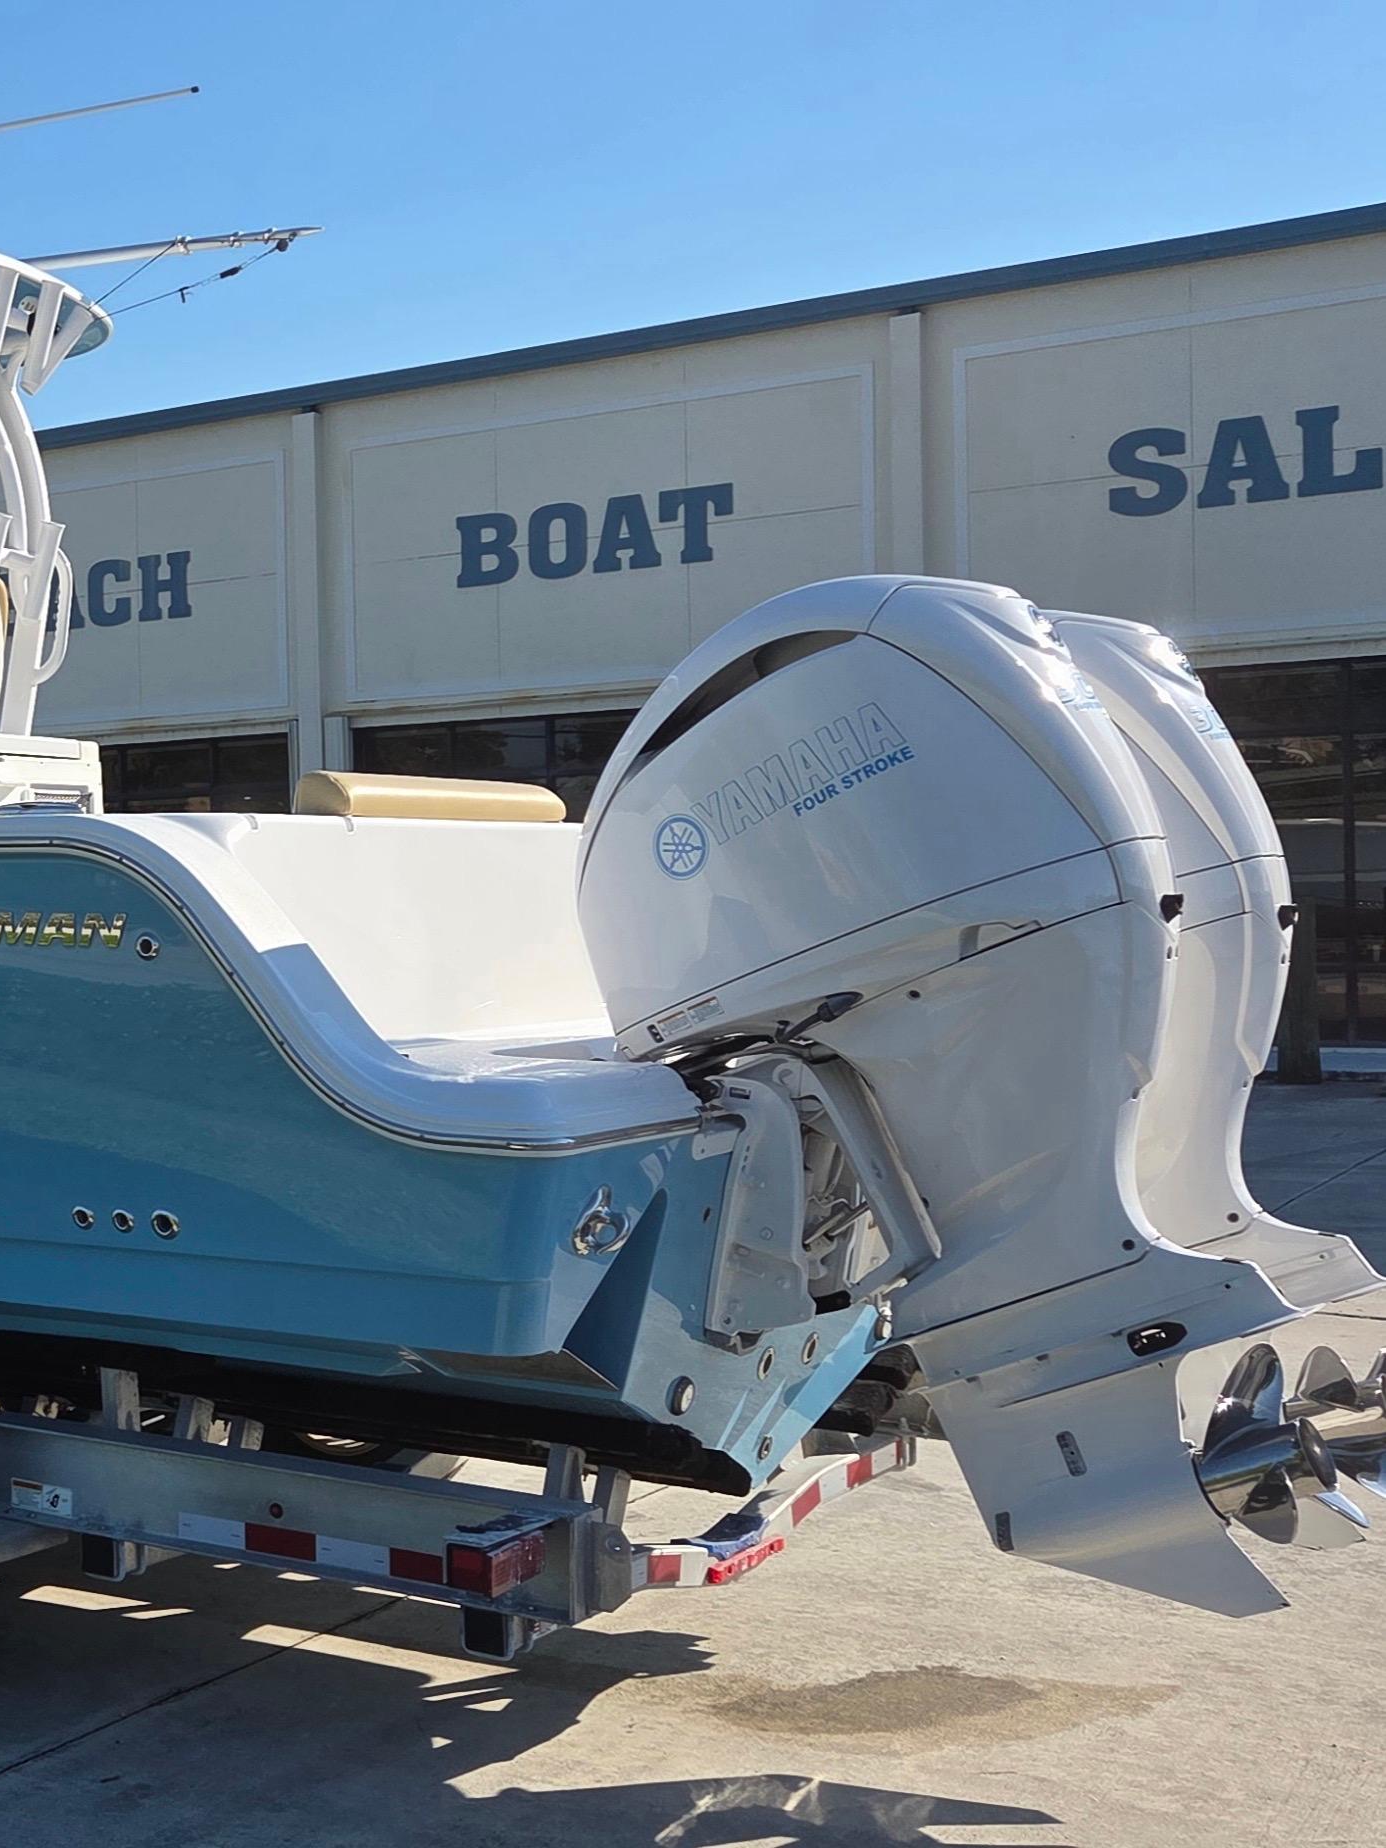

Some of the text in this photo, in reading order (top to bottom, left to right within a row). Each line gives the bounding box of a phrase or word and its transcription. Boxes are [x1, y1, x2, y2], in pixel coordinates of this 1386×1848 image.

[456, 482, 734, 588] BOAT
[1108, 405, 1384, 518] SAL
[690, 702, 907, 846] YAMAHA
[793, 746, 915, 817] FOUR STROKE
